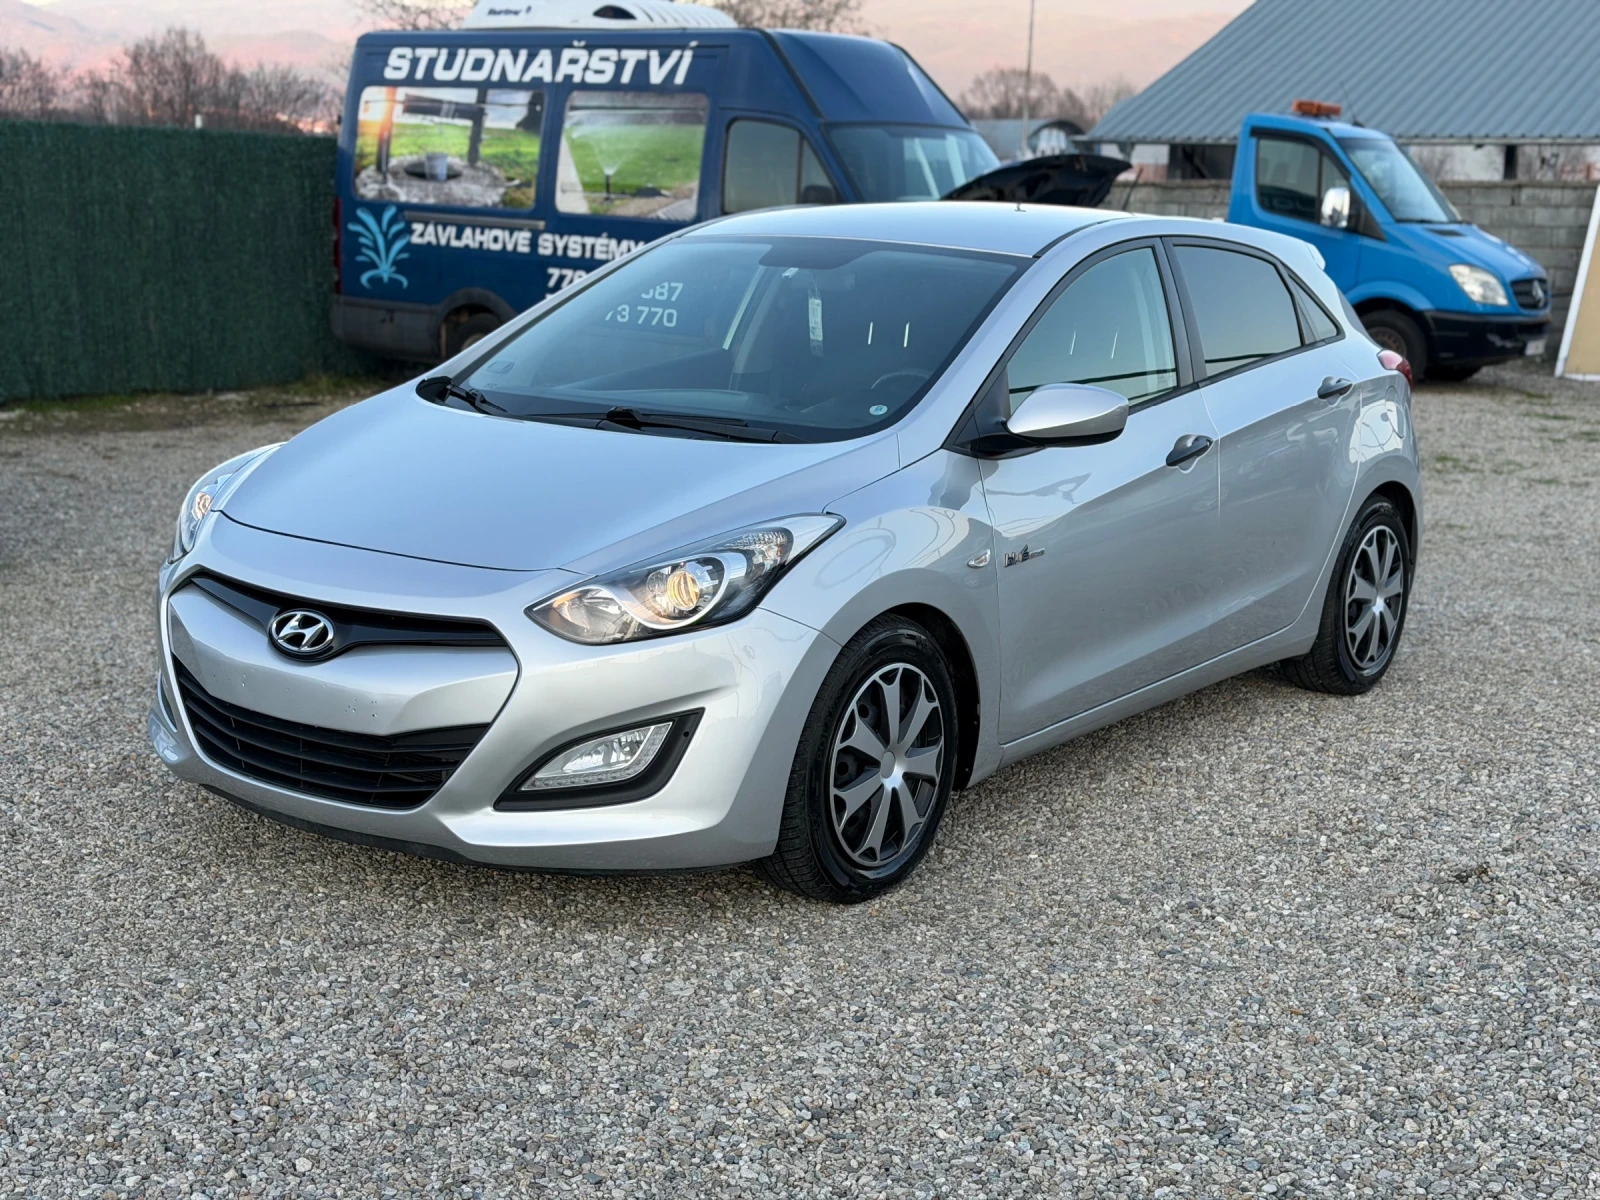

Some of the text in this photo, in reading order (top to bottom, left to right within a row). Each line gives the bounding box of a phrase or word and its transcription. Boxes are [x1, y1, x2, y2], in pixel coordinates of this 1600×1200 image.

[384, 40, 698, 84] STUDNAŘSTVÍ
[410, 222, 531, 252] ZÁVLAHOVÉ
[637, 305, 678, 328] 770
